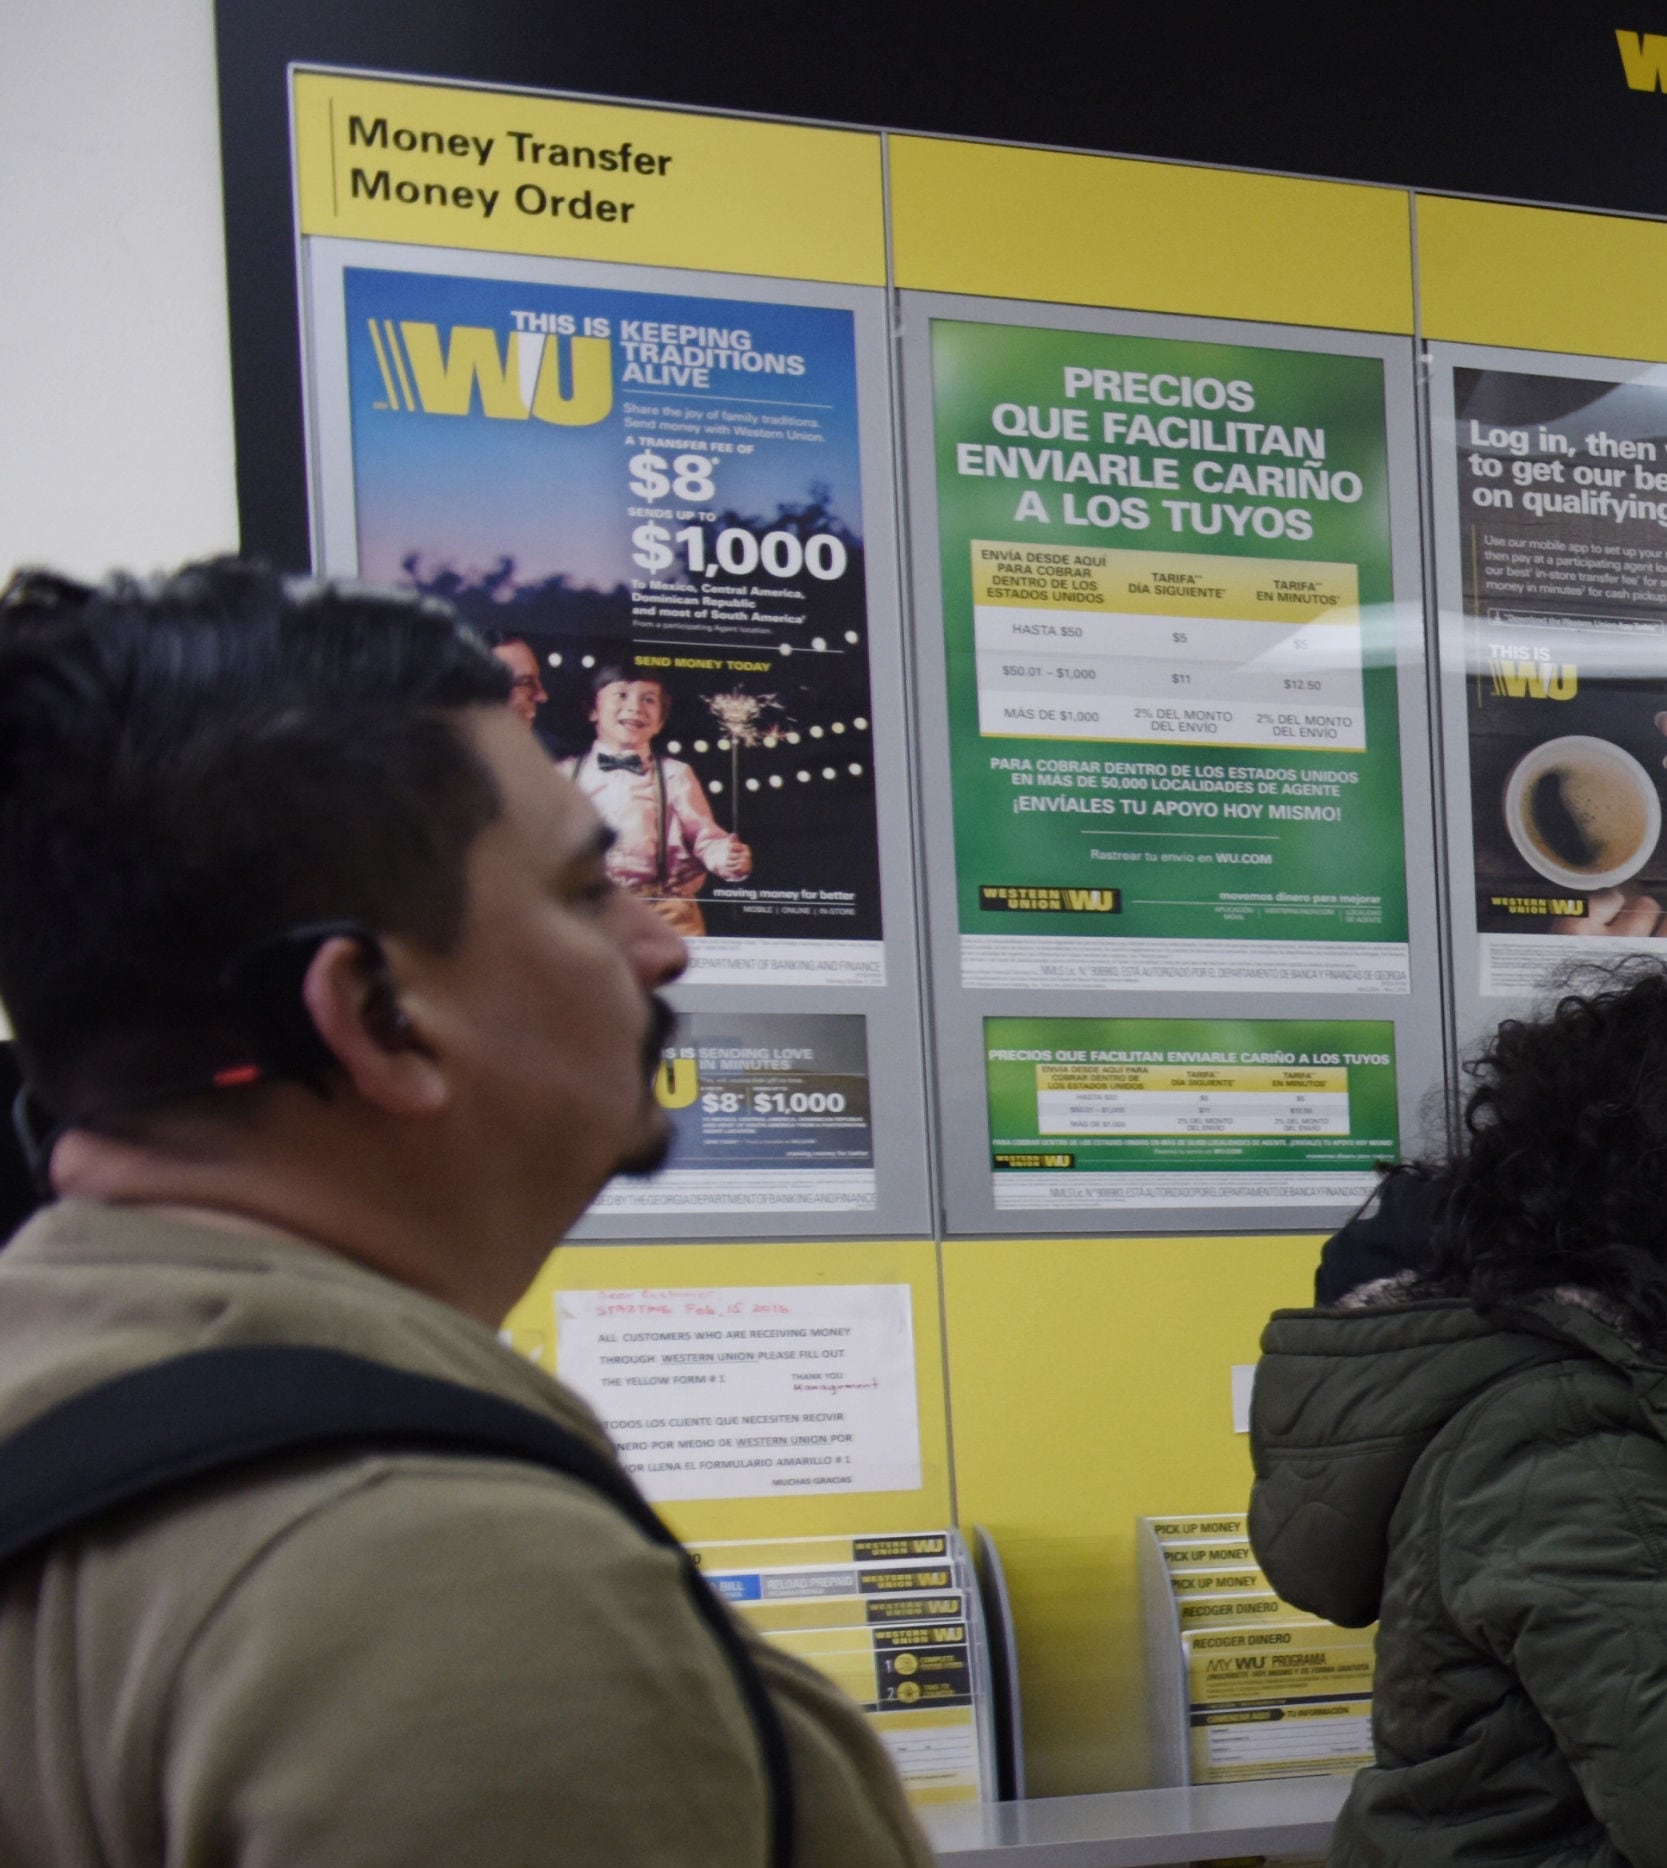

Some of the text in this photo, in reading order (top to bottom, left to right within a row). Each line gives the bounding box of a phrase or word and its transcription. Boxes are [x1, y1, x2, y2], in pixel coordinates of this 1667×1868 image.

[348, 114, 673, 176] Money Transfer
[350, 167, 635, 223] Money Order
[511, 310, 610, 338] THIS IS
[620, 319, 751, 350] KEEPING
[620, 341, 806, 376] TRADITIONS
[400, 320, 614, 428] WU
[621, 364, 710, 389] ALIVE
[1063, 366, 1255, 413] PRECIOS
[992, 402, 1326, 460] QUE FACILITAN
[1470, 418, 1529, 456] Log
[1538, 426, 1576, 458] in,
[1585, 430, 1657, 461] then
[956, 443, 1363, 504] ENVIARLE CARIÑO
[1468, 453, 1503, 478] to
[1511, 459, 1564, 486] get
[1573, 465, 1627, 488] our
[1472, 487, 1514, 509] on
[1014, 490, 1314, 541] A LOS TUYOS
[631, 519, 847, 581] $1,000
[1012, 624, 1082, 639] HASTA $50
[1172, 631, 1188, 644] $5
[634, 655, 771, 672] SEND MONEY TODAY
[1489, 643, 1550, 662] THIS IS
[1002, 664, 1096, 681] $50.01 $1,000
[1172, 672, 1191, 685] $11
[1501, 661, 1578, 701] WU
[1284, 678, 1321, 692] $12.50
[990, 757, 1358, 784] PARA COBRAR DENTRO DE LOS ESTADOS UNIDOS
[1011, 773, 1341, 797] EN MÁS DE 50,000 LOCALIDADES DE AGENTE
[1013, 796, 1342, 822] ¡ENVÍALES TU APOYO HOY MISMO!
[983, 887, 1059, 899] WESTERN
[1068, 890, 1113, 912] WU
[1491, 896, 1547, 907] WESTERN
[1007, 899, 1061, 910] UNION
[1508, 905, 1547, 915] UNION
[1553, 899, 1583, 917] WU
[698, 1048, 814, 1061] SENDING LOVE
[988, 1049, 1390, 1066] PRECIOS QUE FACILITAN ENVIARLE CARIÑO A LOS TUYOS
[753, 1092, 845, 1115] $1,000
[598, 1327, 851, 1344] ALL CUSTOMERS WHO ARE RECEIVING MONEY
[1155, 1521, 1241, 1535] PICK UP MONEY
[1192, 1633, 1292, 1649] RECOGER DINERO
[1235, 1656, 1265, 1670] WU
[1272, 1653, 1327, 1668] PROGRAMA
